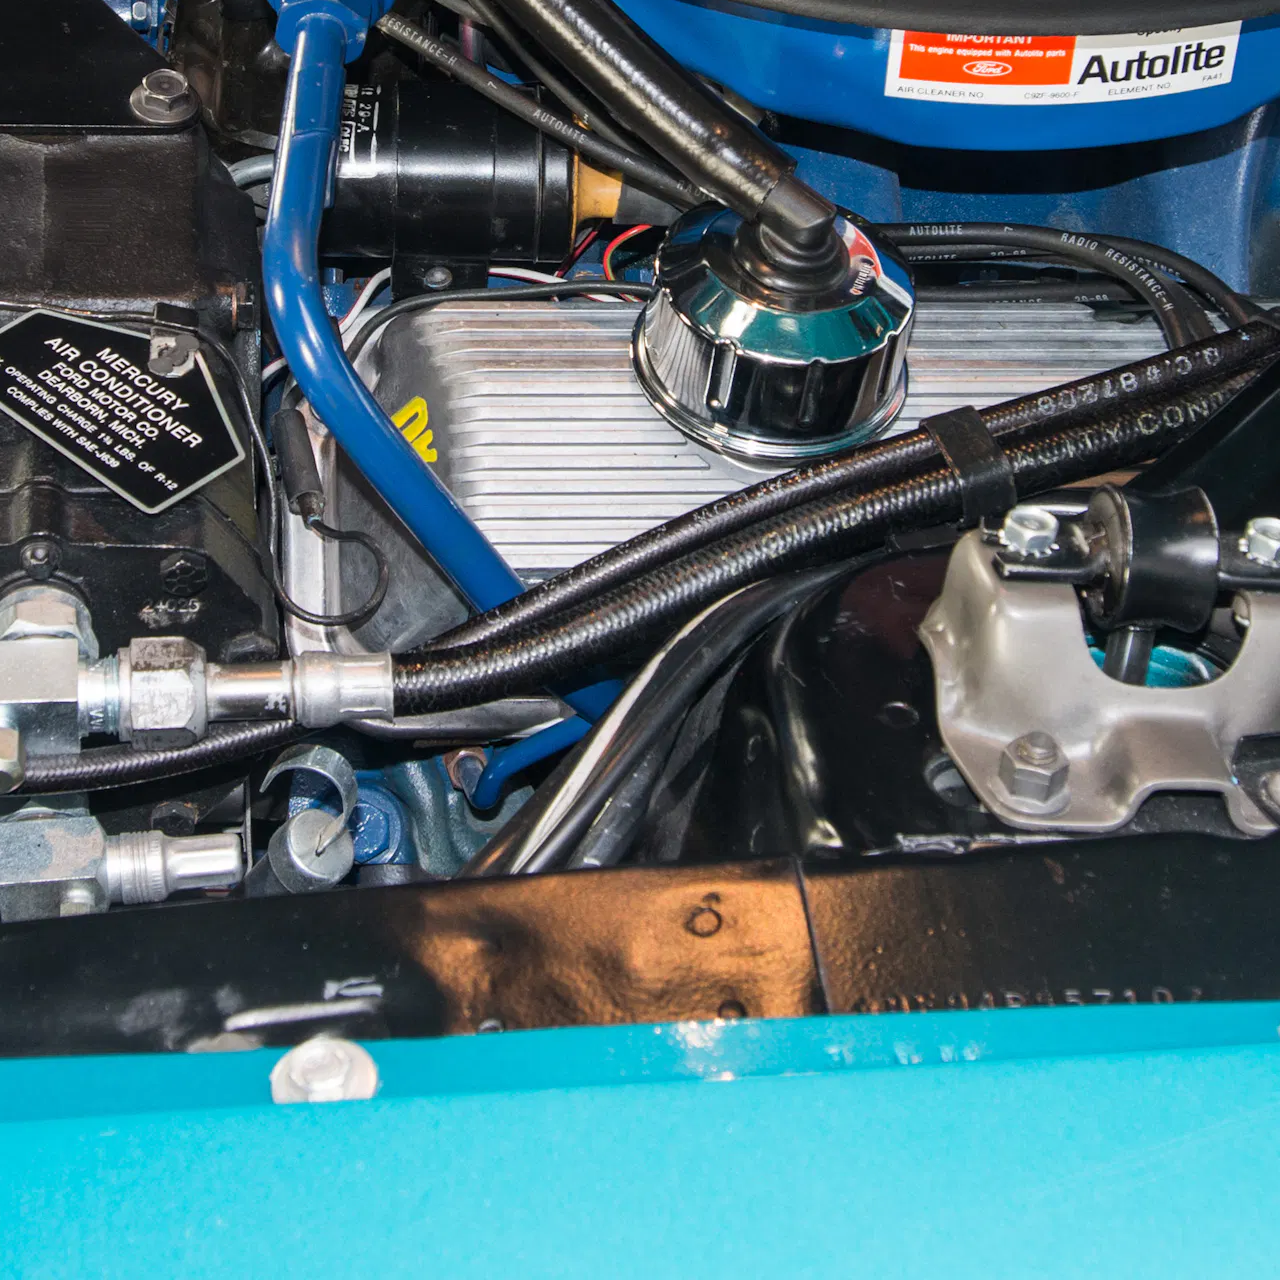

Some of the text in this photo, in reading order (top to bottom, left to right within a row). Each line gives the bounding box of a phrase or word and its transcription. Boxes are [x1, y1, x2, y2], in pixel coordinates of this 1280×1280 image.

[897, 84, 915, 95] AIR
[916, 87, 967, 98] CLEANER
[1107, 85, 1155, 96] ELEMENT
[972, 61, 1003, 74] Ford
[1077, 42, 1226, 85] Autolite
[530, 107, 589, 146] AUTOLITE
[908, 224, 965, 236] AUTOLITE
[1059, 231, 1098, 250] RADIO
[1104, 246, 1175, 310] RESISTANCE-H
[37, 369, 146, 449] DEARBORN, MICH.
[43, 337, 203, 448] AIR CONDITIONER
[51, 361, 159, 441] FORD MOTOR CO.
[95, 347, 190, 411] MERCURY
[4, 366, 58, 405] OPERATING
[56, 403, 98, 434] CHARGE
[113, 444, 136, 463] LBS.
[137, 461, 156, 473] OF
[153, 472, 178, 491] R-12
[6, 386, 120, 468] COMPLIES WITH SAE-J639
